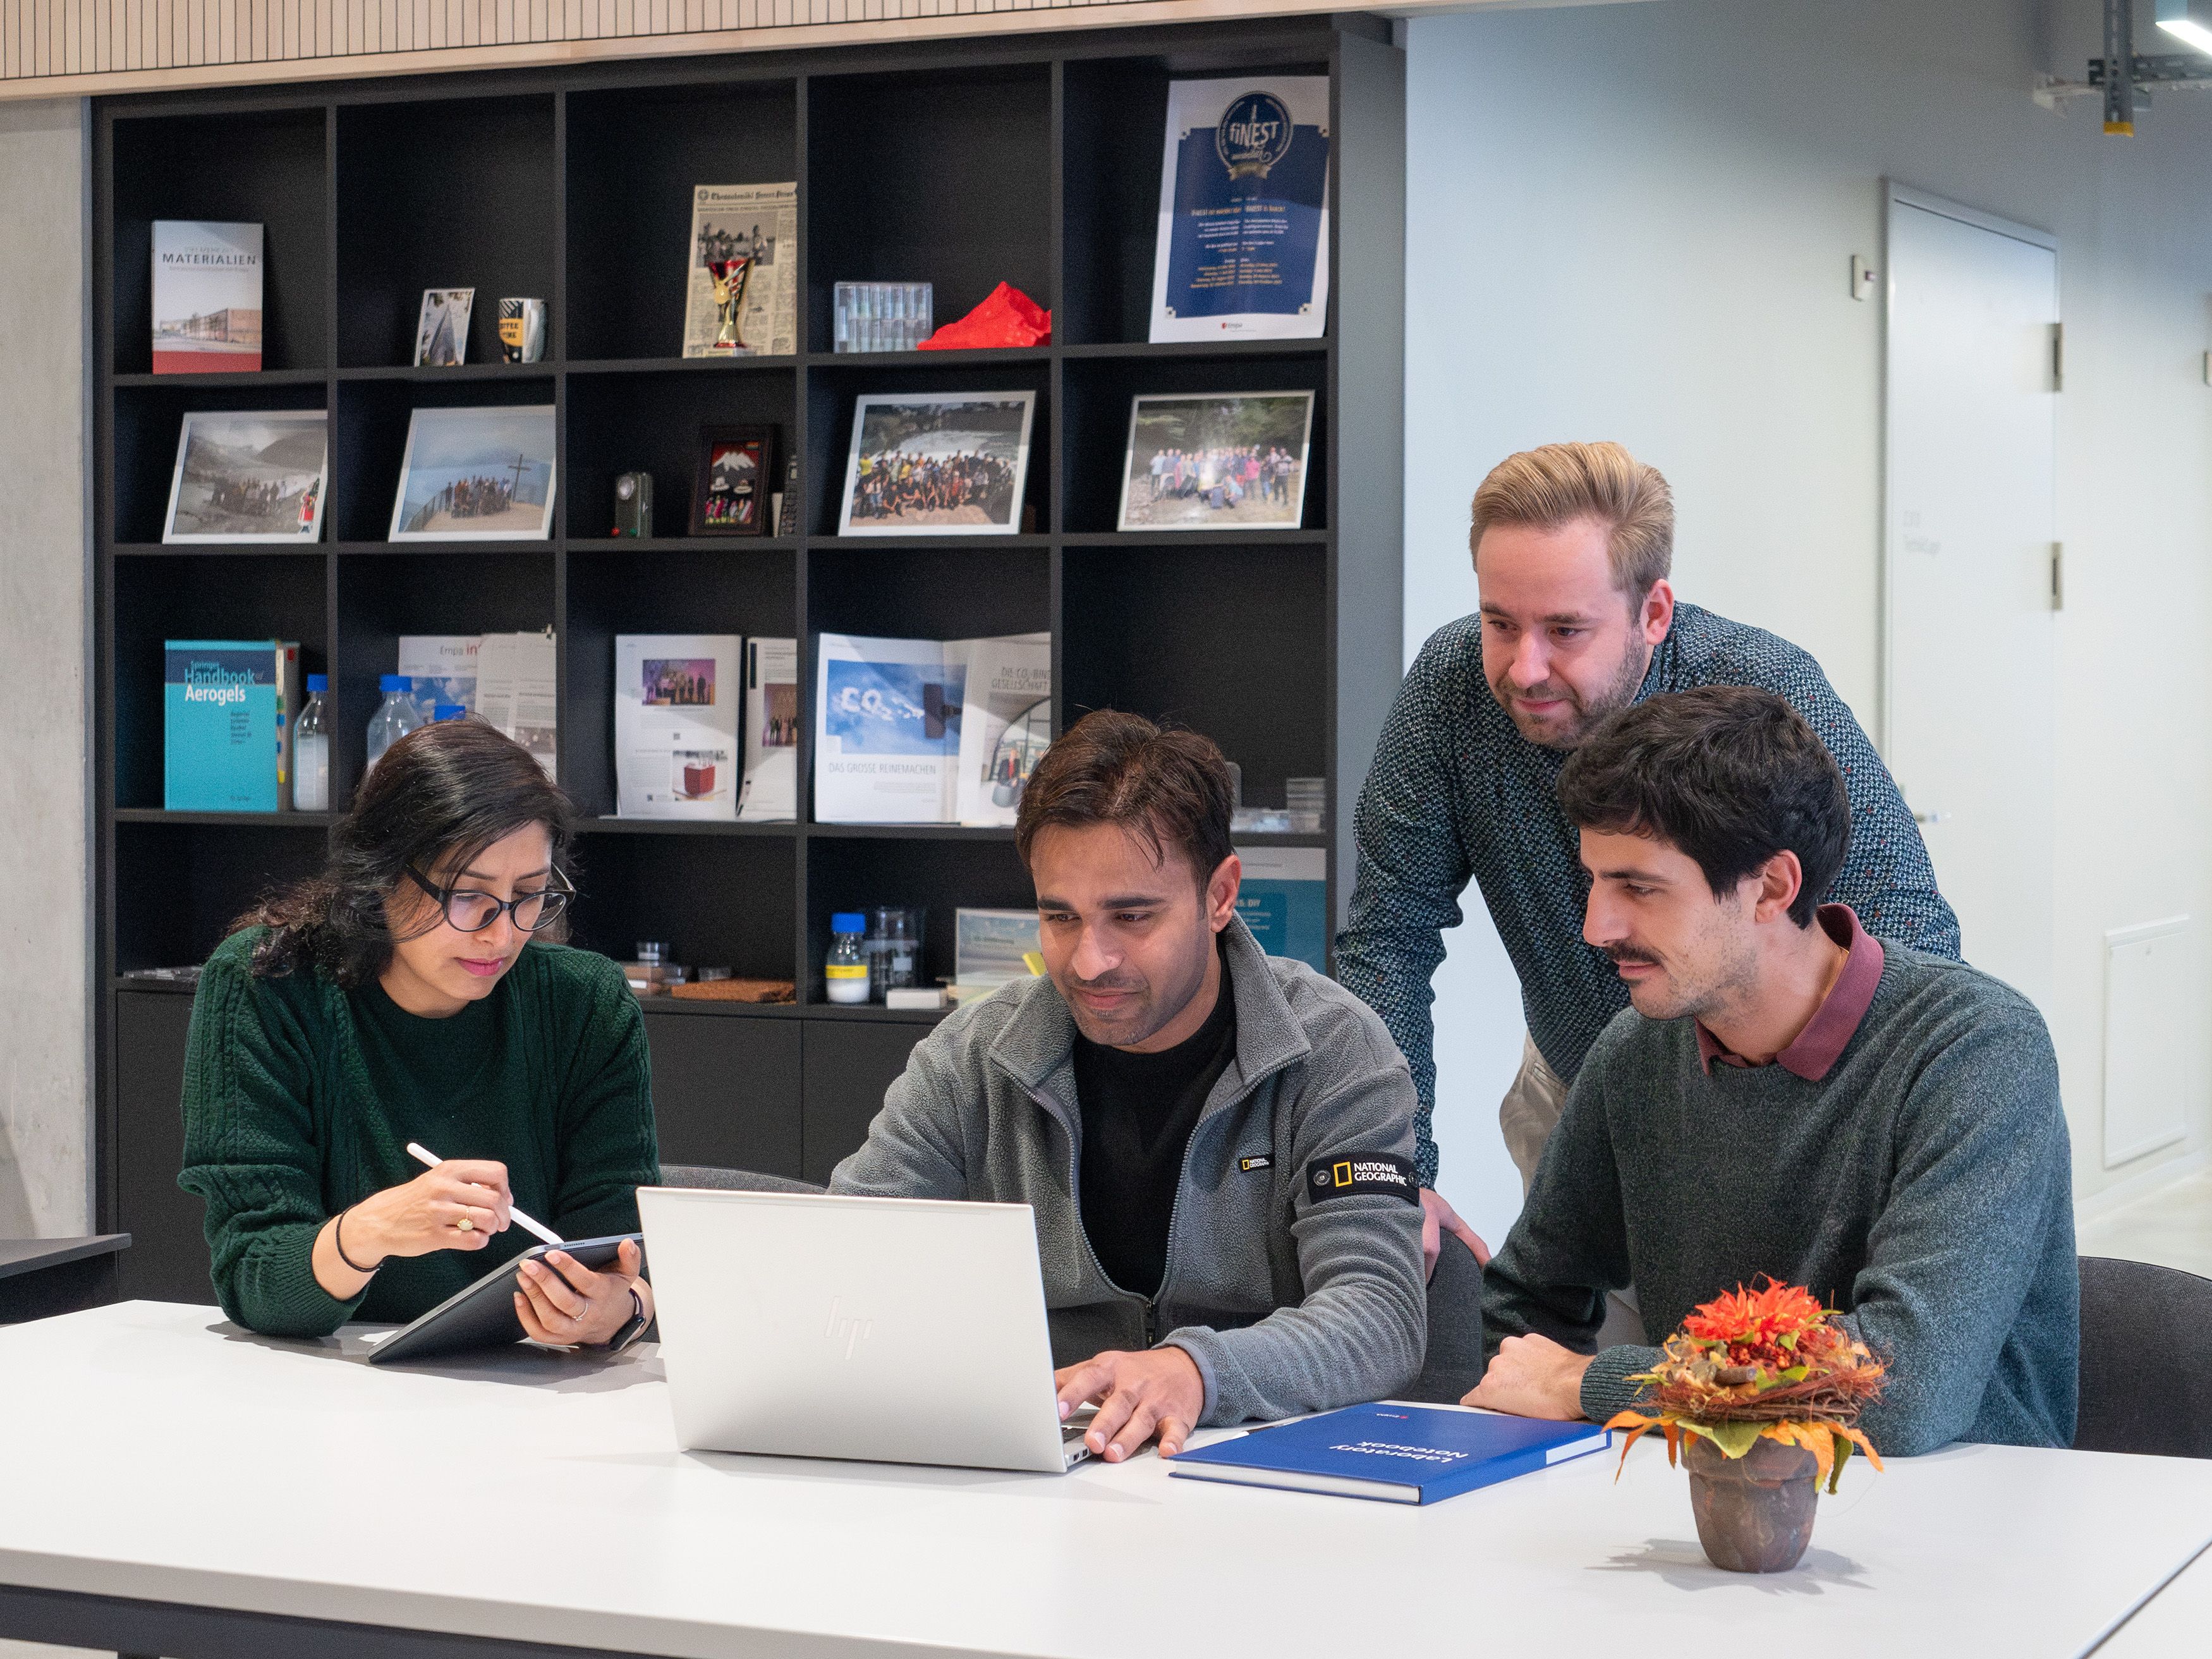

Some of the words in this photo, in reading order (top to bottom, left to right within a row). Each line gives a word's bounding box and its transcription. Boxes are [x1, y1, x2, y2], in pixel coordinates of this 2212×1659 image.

[162, 253, 256, 265] MATERIALIEN
[185, 668, 255, 684] Handbook
[185, 684, 246, 706] Aerogels
[829, 762, 844, 773] DAS
[847, 762, 877, 774] GROSSE
[879, 763, 937, 775] REINEMACHEN
[1354, 1162, 1398, 1174] NATIONAL
[1354, 1172, 1407, 1186] GEOGRAPHIC
[823, 1295, 873, 1360] hp
[1328, 1445, 1452, 1462] Laboratory
[1357, 1442, 1468, 1458] Notebook
